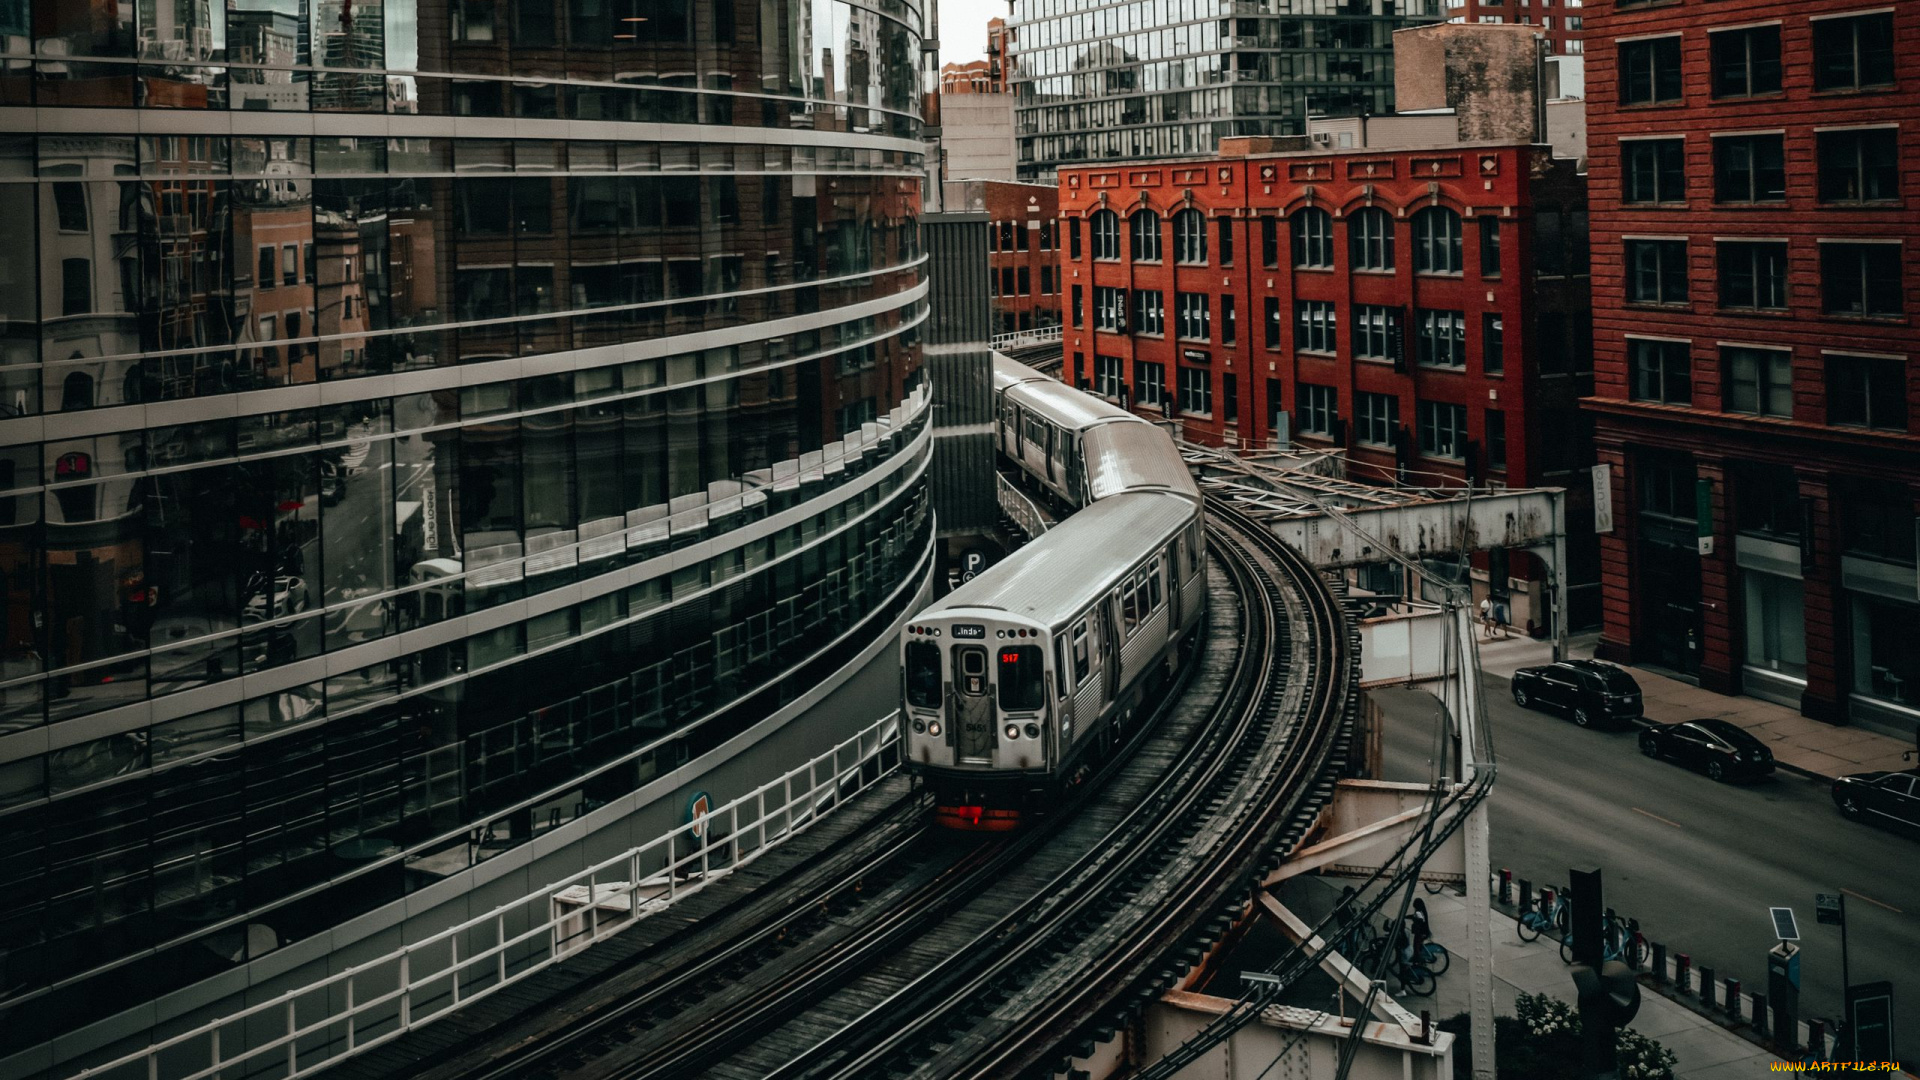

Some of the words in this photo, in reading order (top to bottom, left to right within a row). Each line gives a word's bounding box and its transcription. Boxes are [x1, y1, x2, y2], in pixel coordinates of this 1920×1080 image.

[1596, 470, 1606, 512] CURO
[968, 553, 981, 571] P
[1002, 653, 1019, 663] 517
